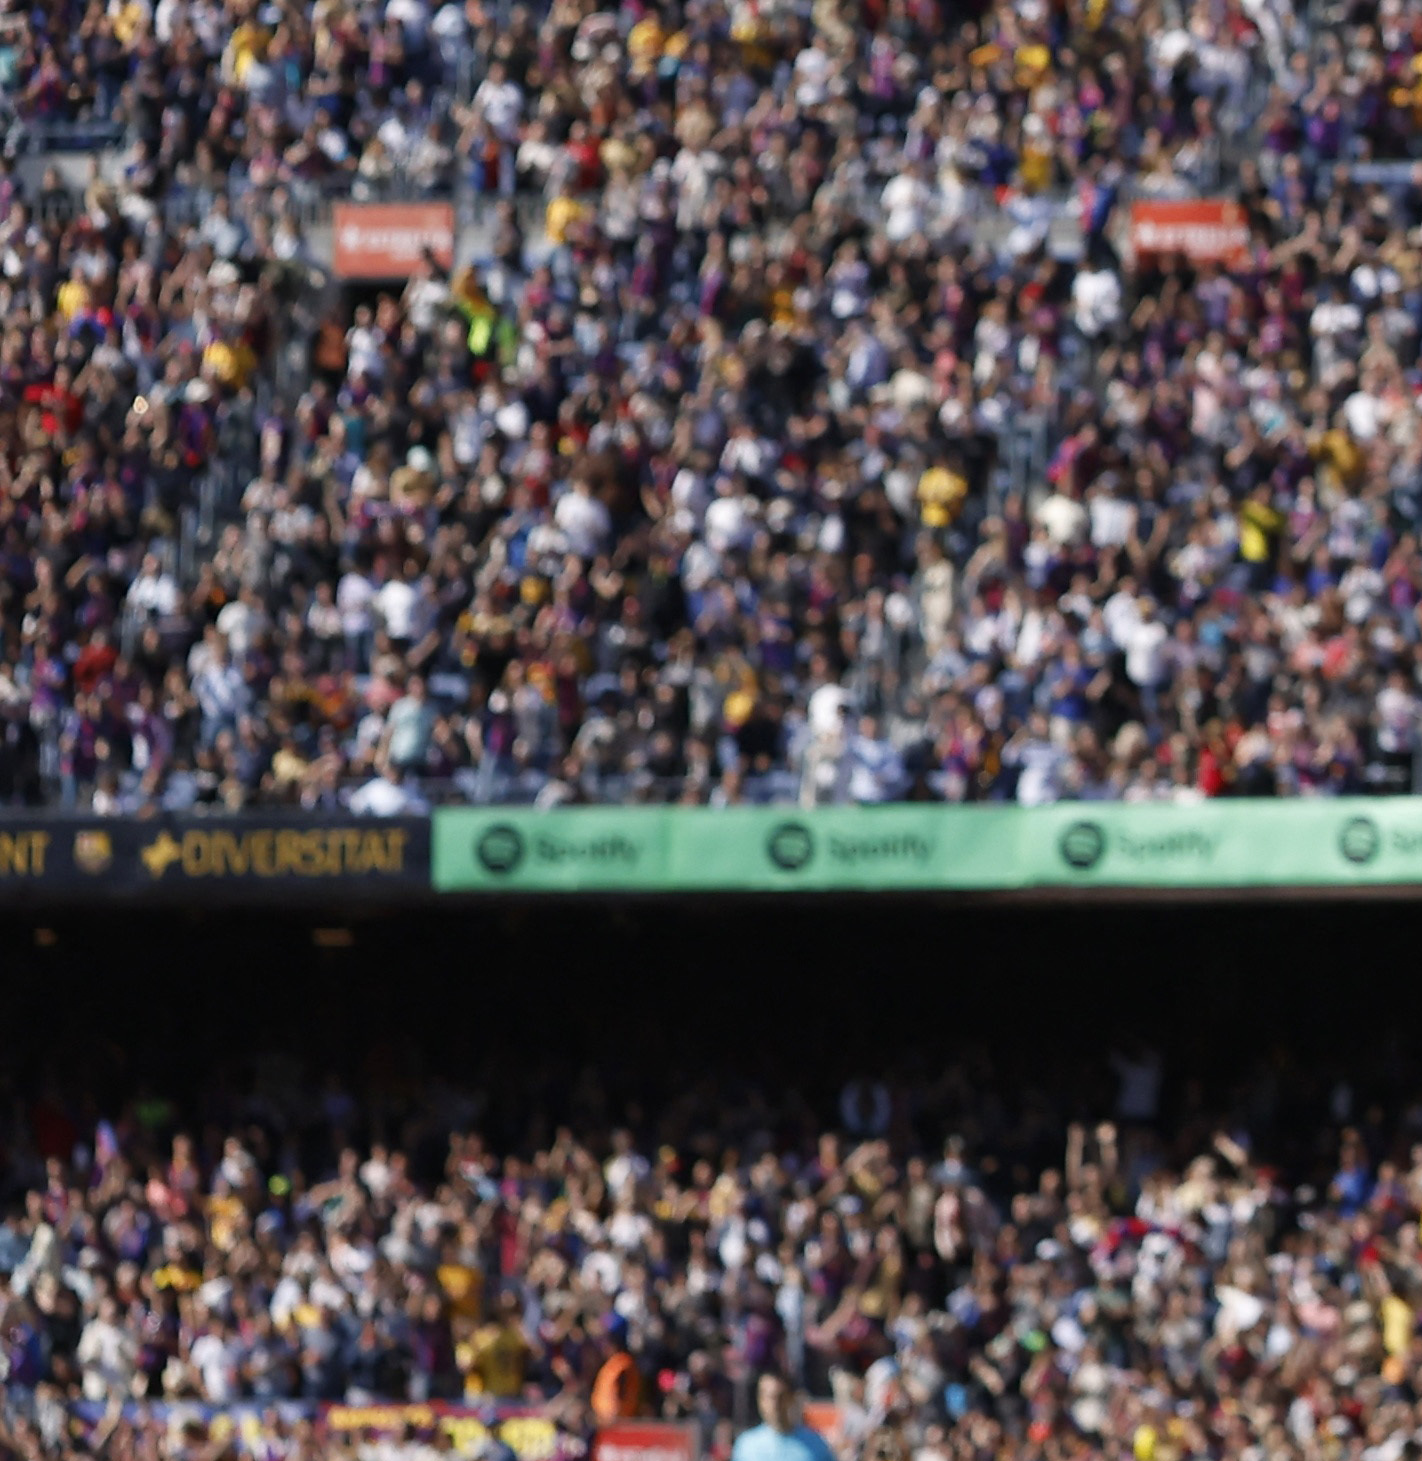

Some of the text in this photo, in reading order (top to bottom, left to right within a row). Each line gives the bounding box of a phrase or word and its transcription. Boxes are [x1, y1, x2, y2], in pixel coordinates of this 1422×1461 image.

[182, 829, 408, 877] DIVERSITAT
[533, 831, 642, 868] Spotify
[827, 829, 935, 866] Spotify
